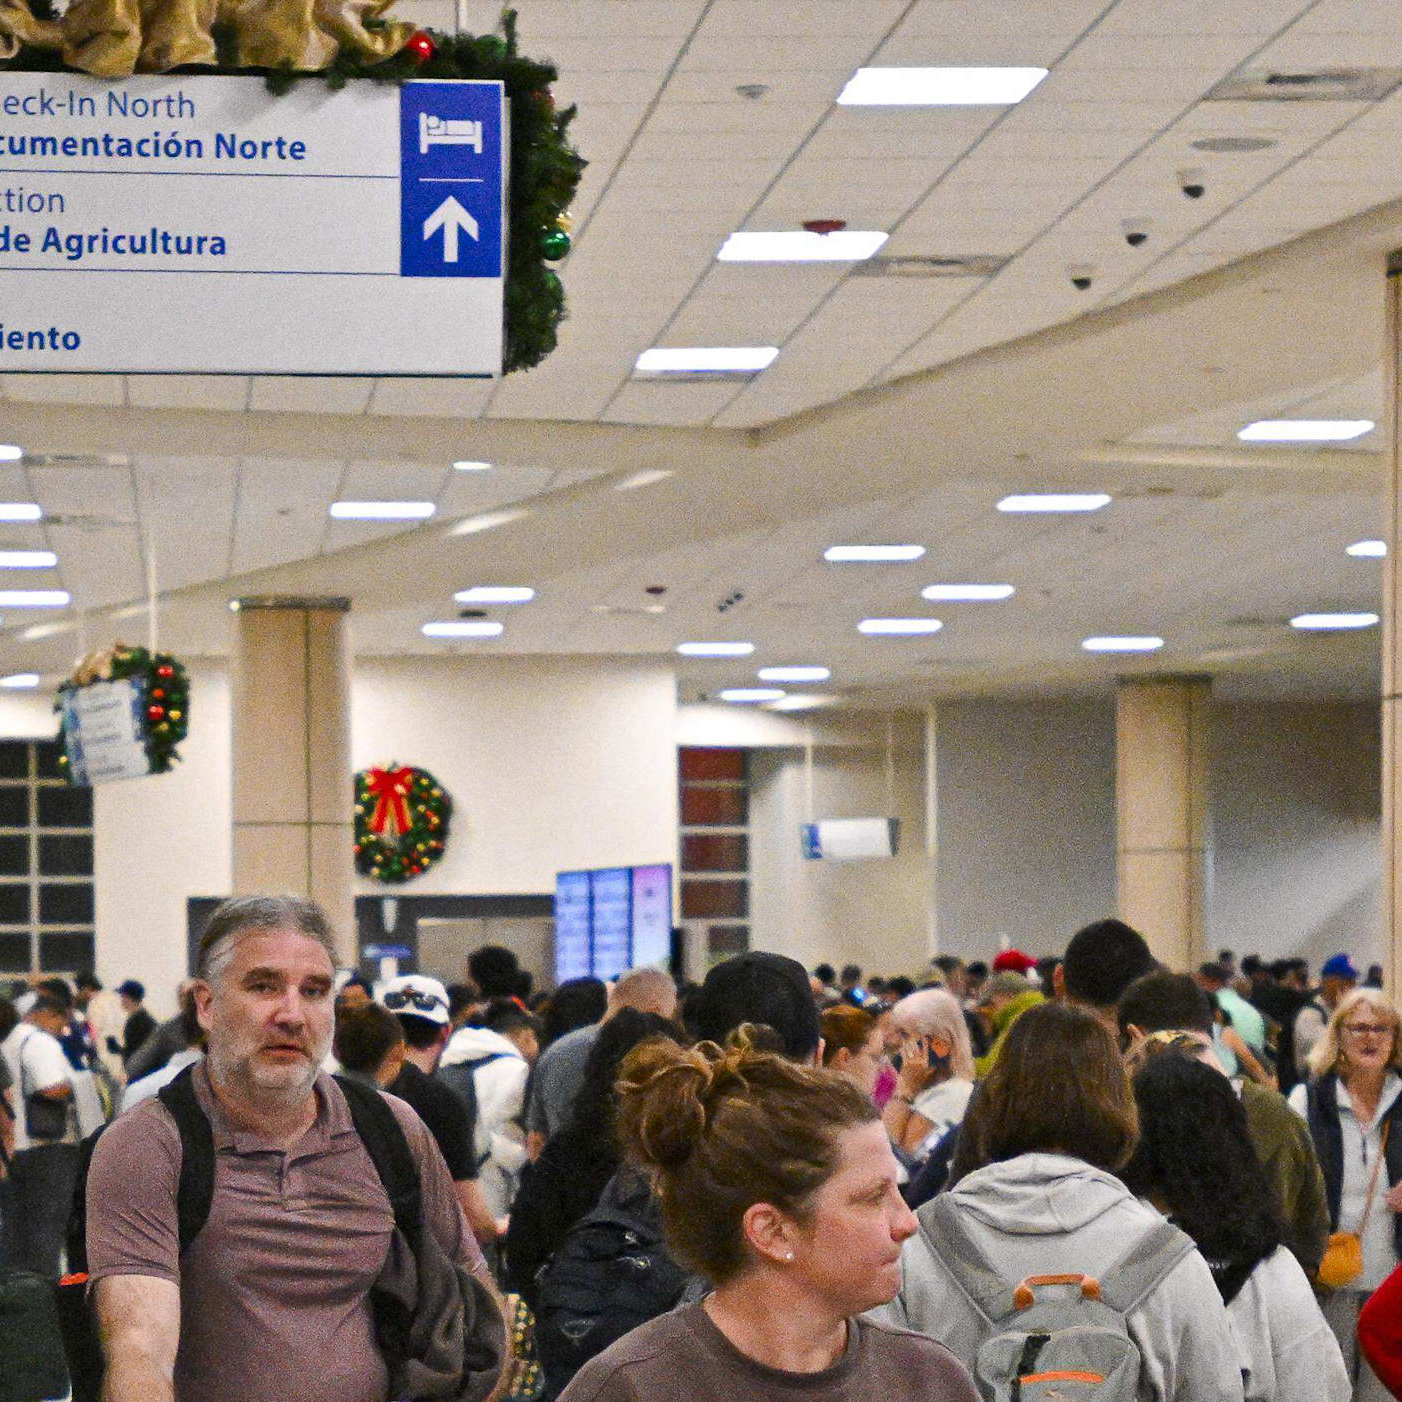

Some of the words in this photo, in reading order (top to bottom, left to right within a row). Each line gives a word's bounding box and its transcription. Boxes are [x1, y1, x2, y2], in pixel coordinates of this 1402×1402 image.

[107, 90, 194, 119] North
[214, 133, 306, 160] Norte
[41, 226, 226, 261] Agricultura
